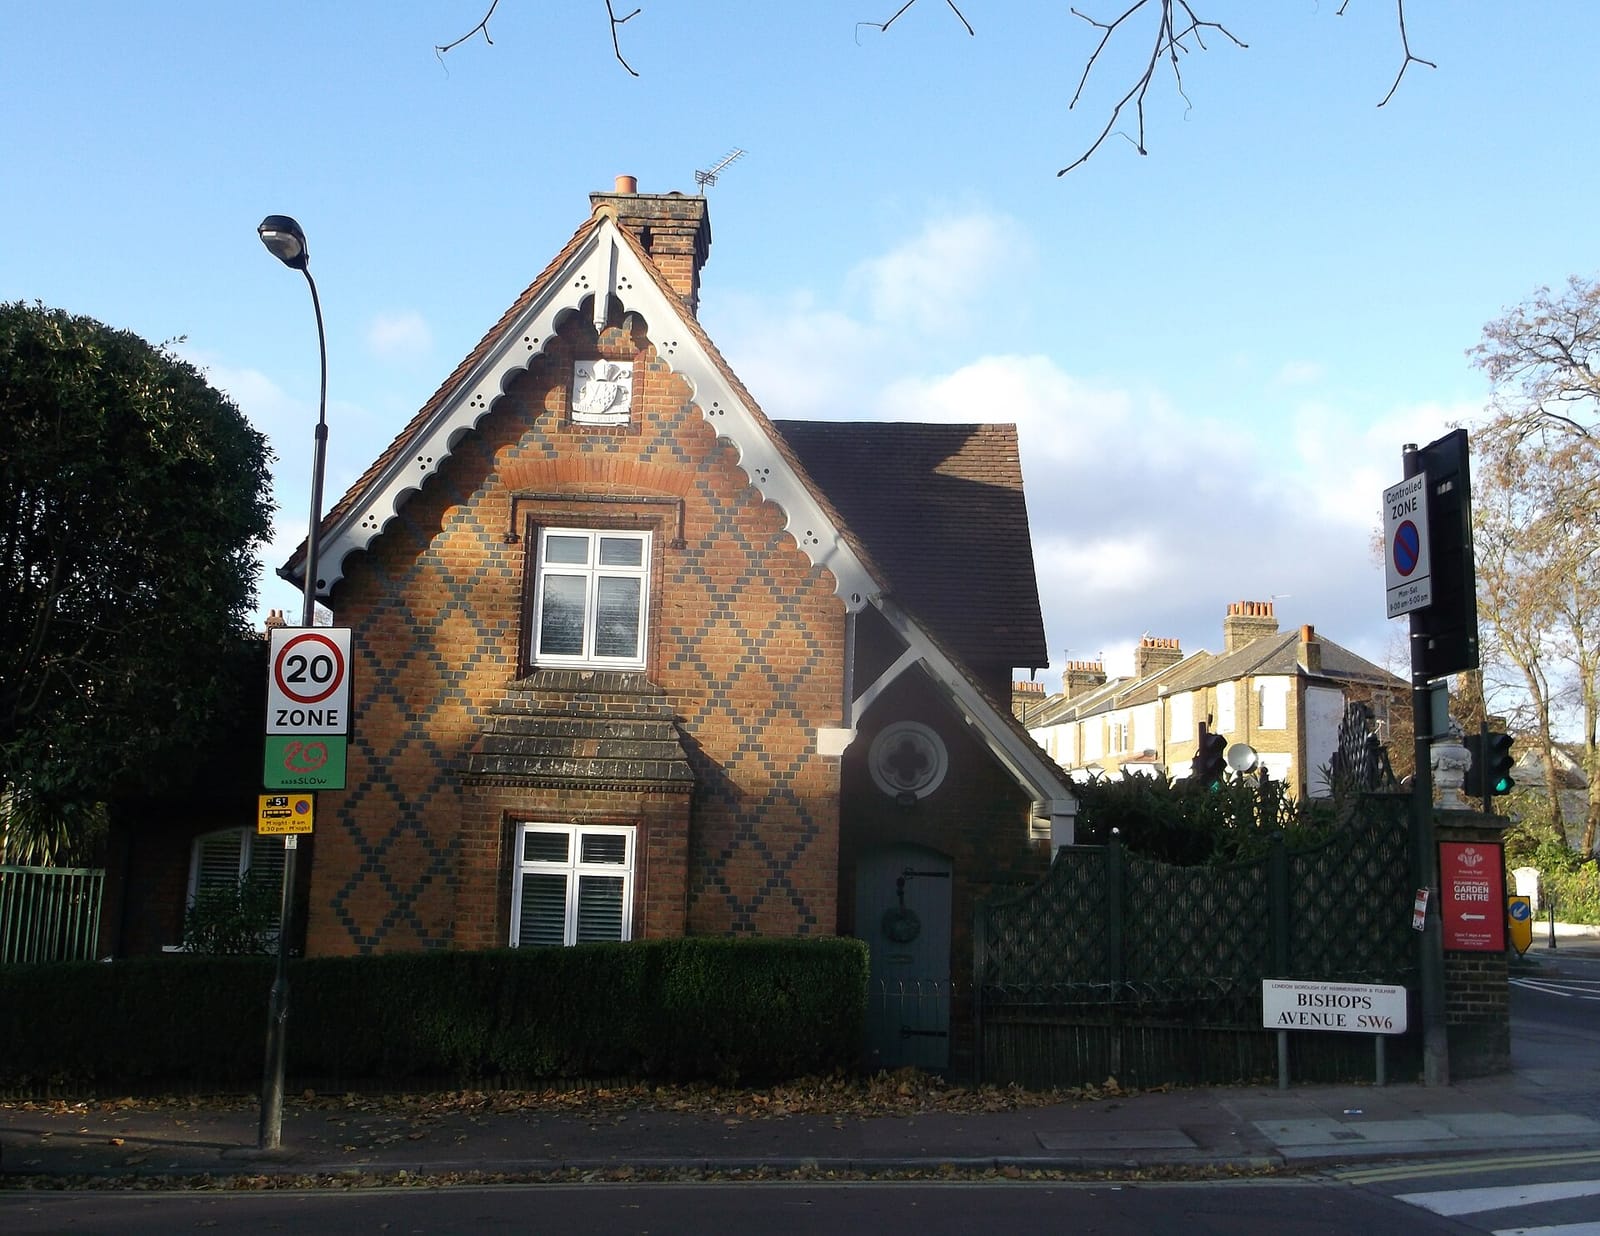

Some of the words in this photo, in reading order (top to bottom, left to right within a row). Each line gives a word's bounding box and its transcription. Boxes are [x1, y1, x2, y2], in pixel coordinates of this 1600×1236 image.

[1386, 479, 1422, 504] Controlled
[1392, 496, 1417, 520] ZONE
[286, 655, 333, 683] 20
[275, 709, 338, 726] ZONE
[1454, 885, 1489, 893] GARDEN
[1454, 893, 1489, 902] CENTRE
[1297, 993, 1372, 1010] BISHOPS
[1277, 1011, 1347, 1027] AVENUE
[1357, 1014, 1393, 1029] SW6
